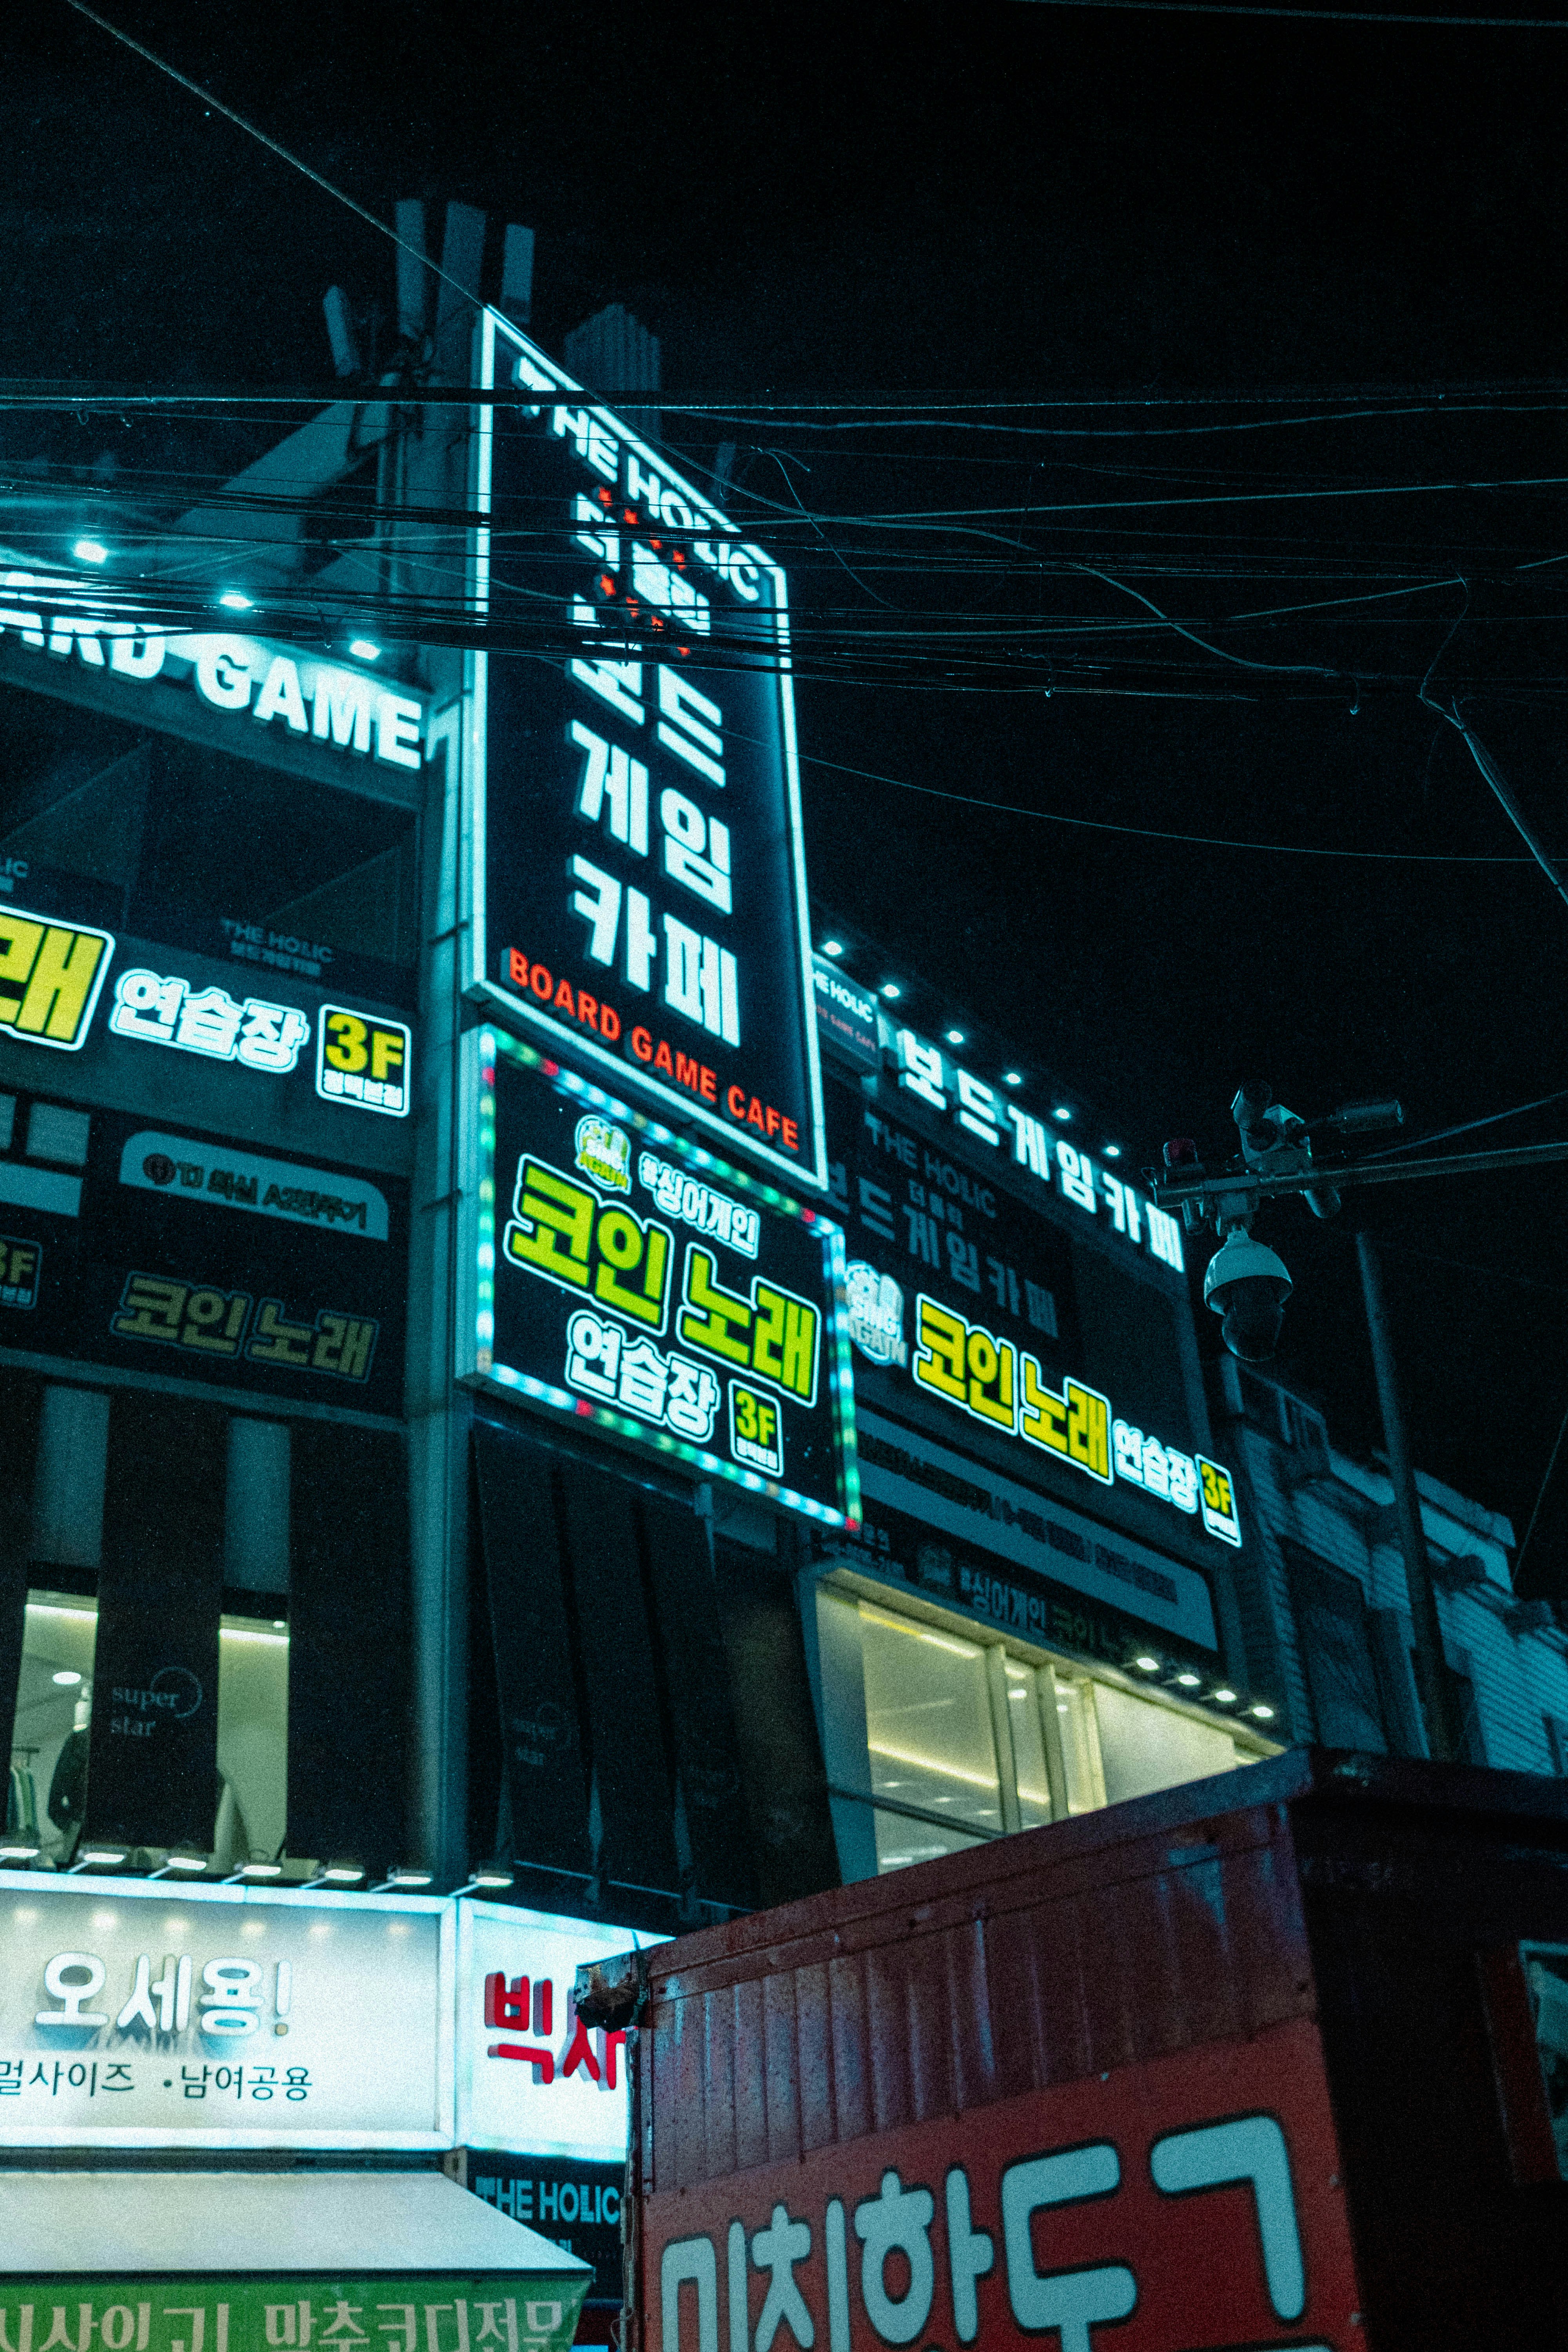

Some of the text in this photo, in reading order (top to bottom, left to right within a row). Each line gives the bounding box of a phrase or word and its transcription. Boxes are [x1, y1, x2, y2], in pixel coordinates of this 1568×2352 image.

[519, 357, 758, 601] THE HOLIC
[196, 643, 421, 769] GAME
[572, 720, 731, 915] 게임
[573, 853, 739, 1047] 카페
[114, 972, 306, 1069] 연습장
[326, 1014, 403, 1079] 3F
[509, 947, 799, 1151] BOARD GAME CAFE
[864, 1111, 996, 1219] THE HOLIC
[570, 1317, 717, 1436] 연습장
[736, 1390, 775, 1445] 3F
[1116, 1424, 1197, 1510] 연습장
[1201, 1463, 1231, 1514] 3F
[110, 1715, 156, 1738] star
[112, 1686, 181, 1711] super
[34, 1951, 292, 2037] 오세용!
[475, 2176, 621, 2225] THE HOLIC
